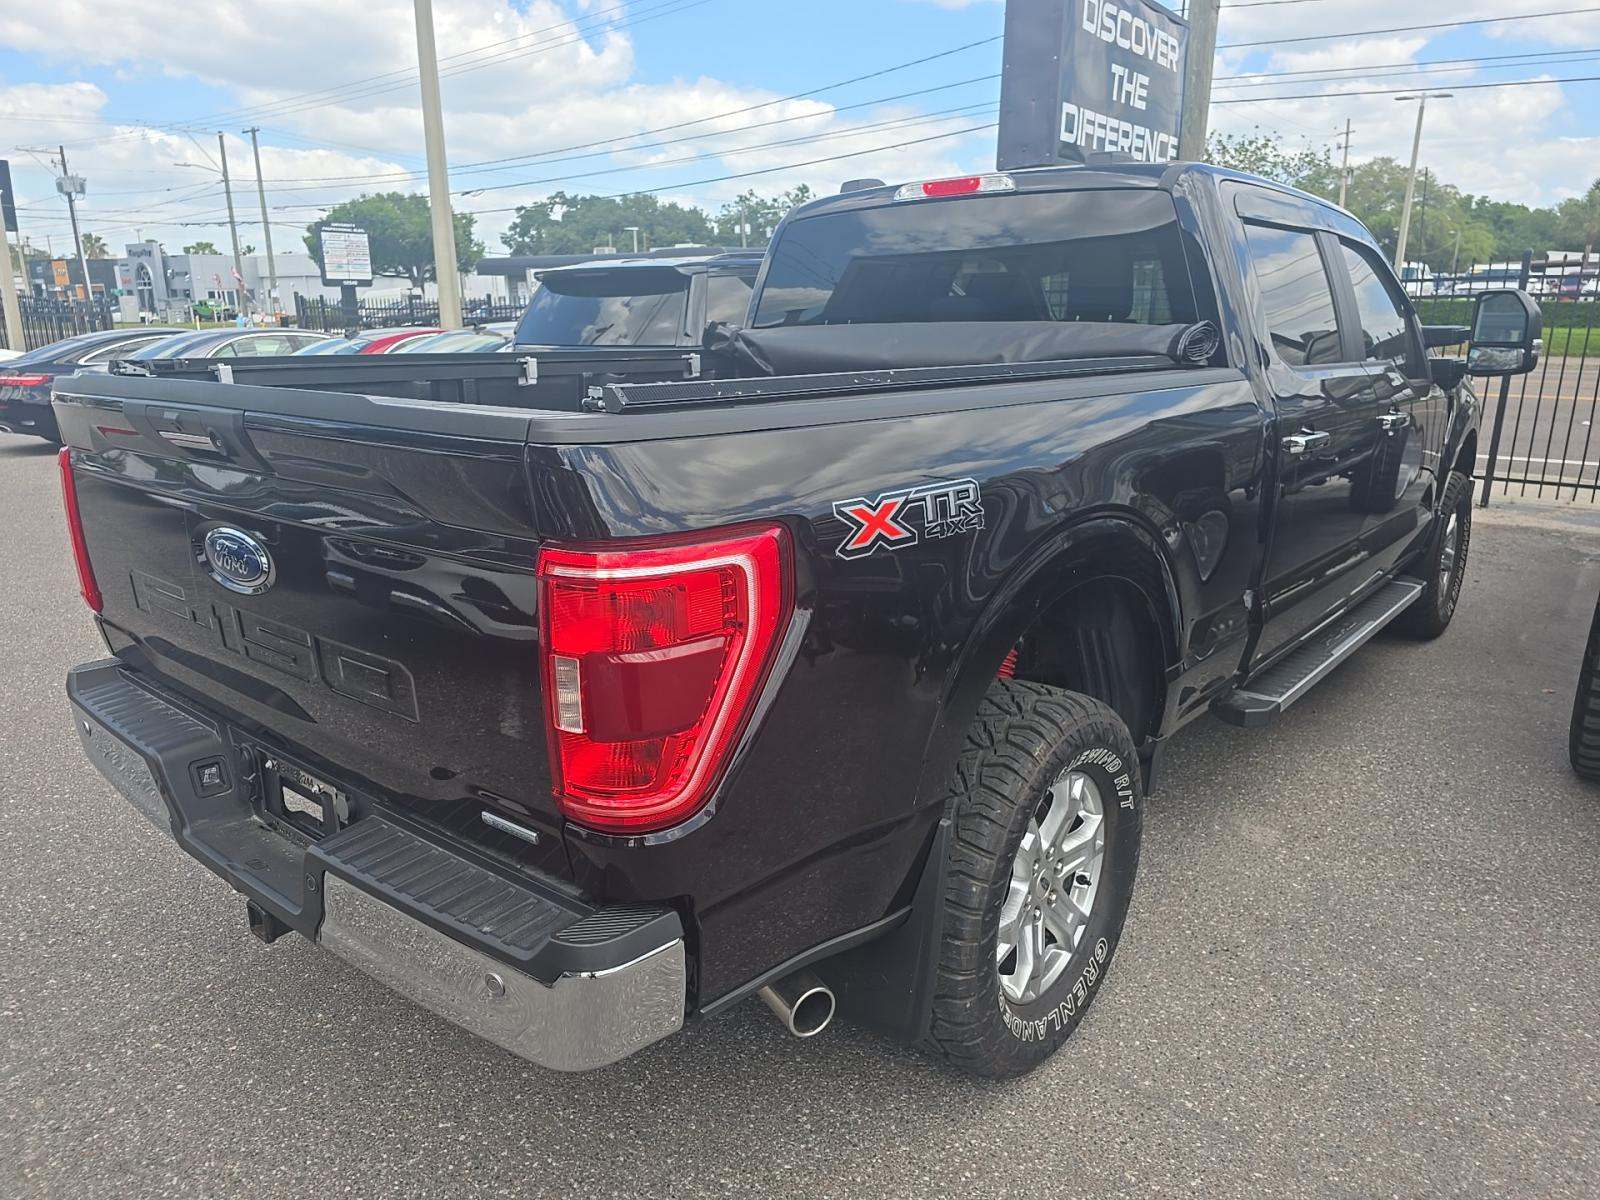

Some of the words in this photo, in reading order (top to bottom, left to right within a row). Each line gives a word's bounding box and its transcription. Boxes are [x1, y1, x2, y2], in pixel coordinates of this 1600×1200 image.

[1082, 0, 1179, 72] DISCOVER
[1111, 63, 1150, 110] THE
[1060, 101, 1179, 162] DIFFERENCE
[215, 538, 256, 575] Ford
